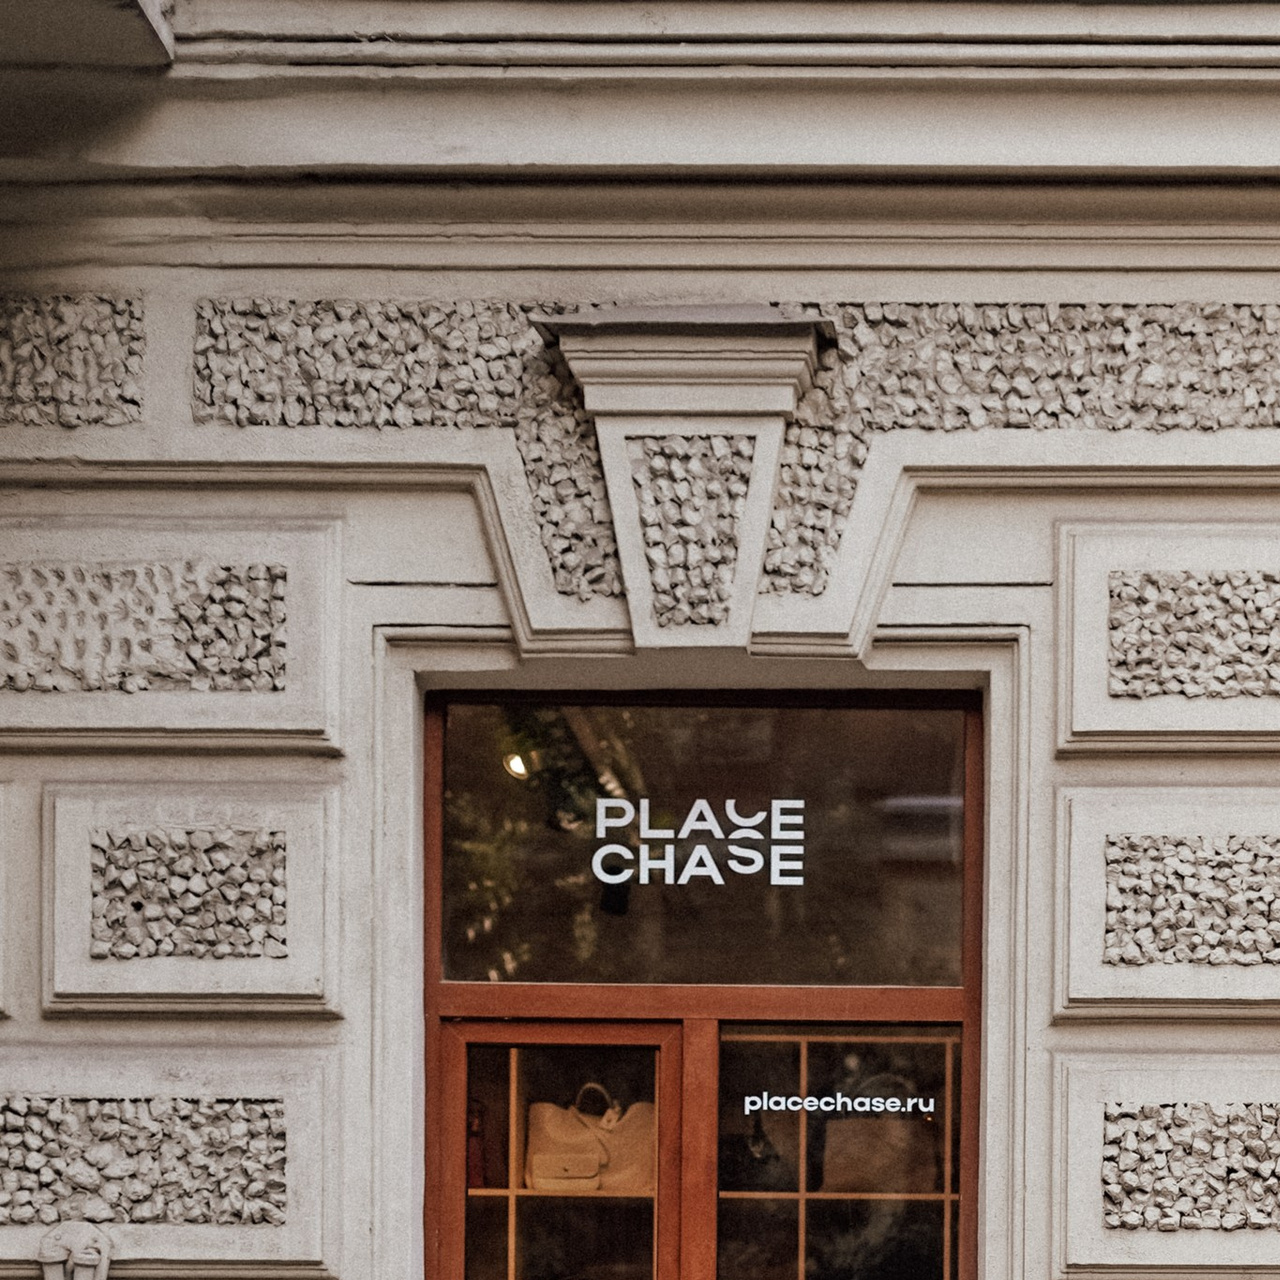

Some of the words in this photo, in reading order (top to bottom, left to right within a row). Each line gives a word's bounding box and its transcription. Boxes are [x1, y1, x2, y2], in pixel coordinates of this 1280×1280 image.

[596, 799, 805, 840] PLACE
[592, 844, 805, 886] CHASE
[744, 1091, 936, 1115] placechase.ru
